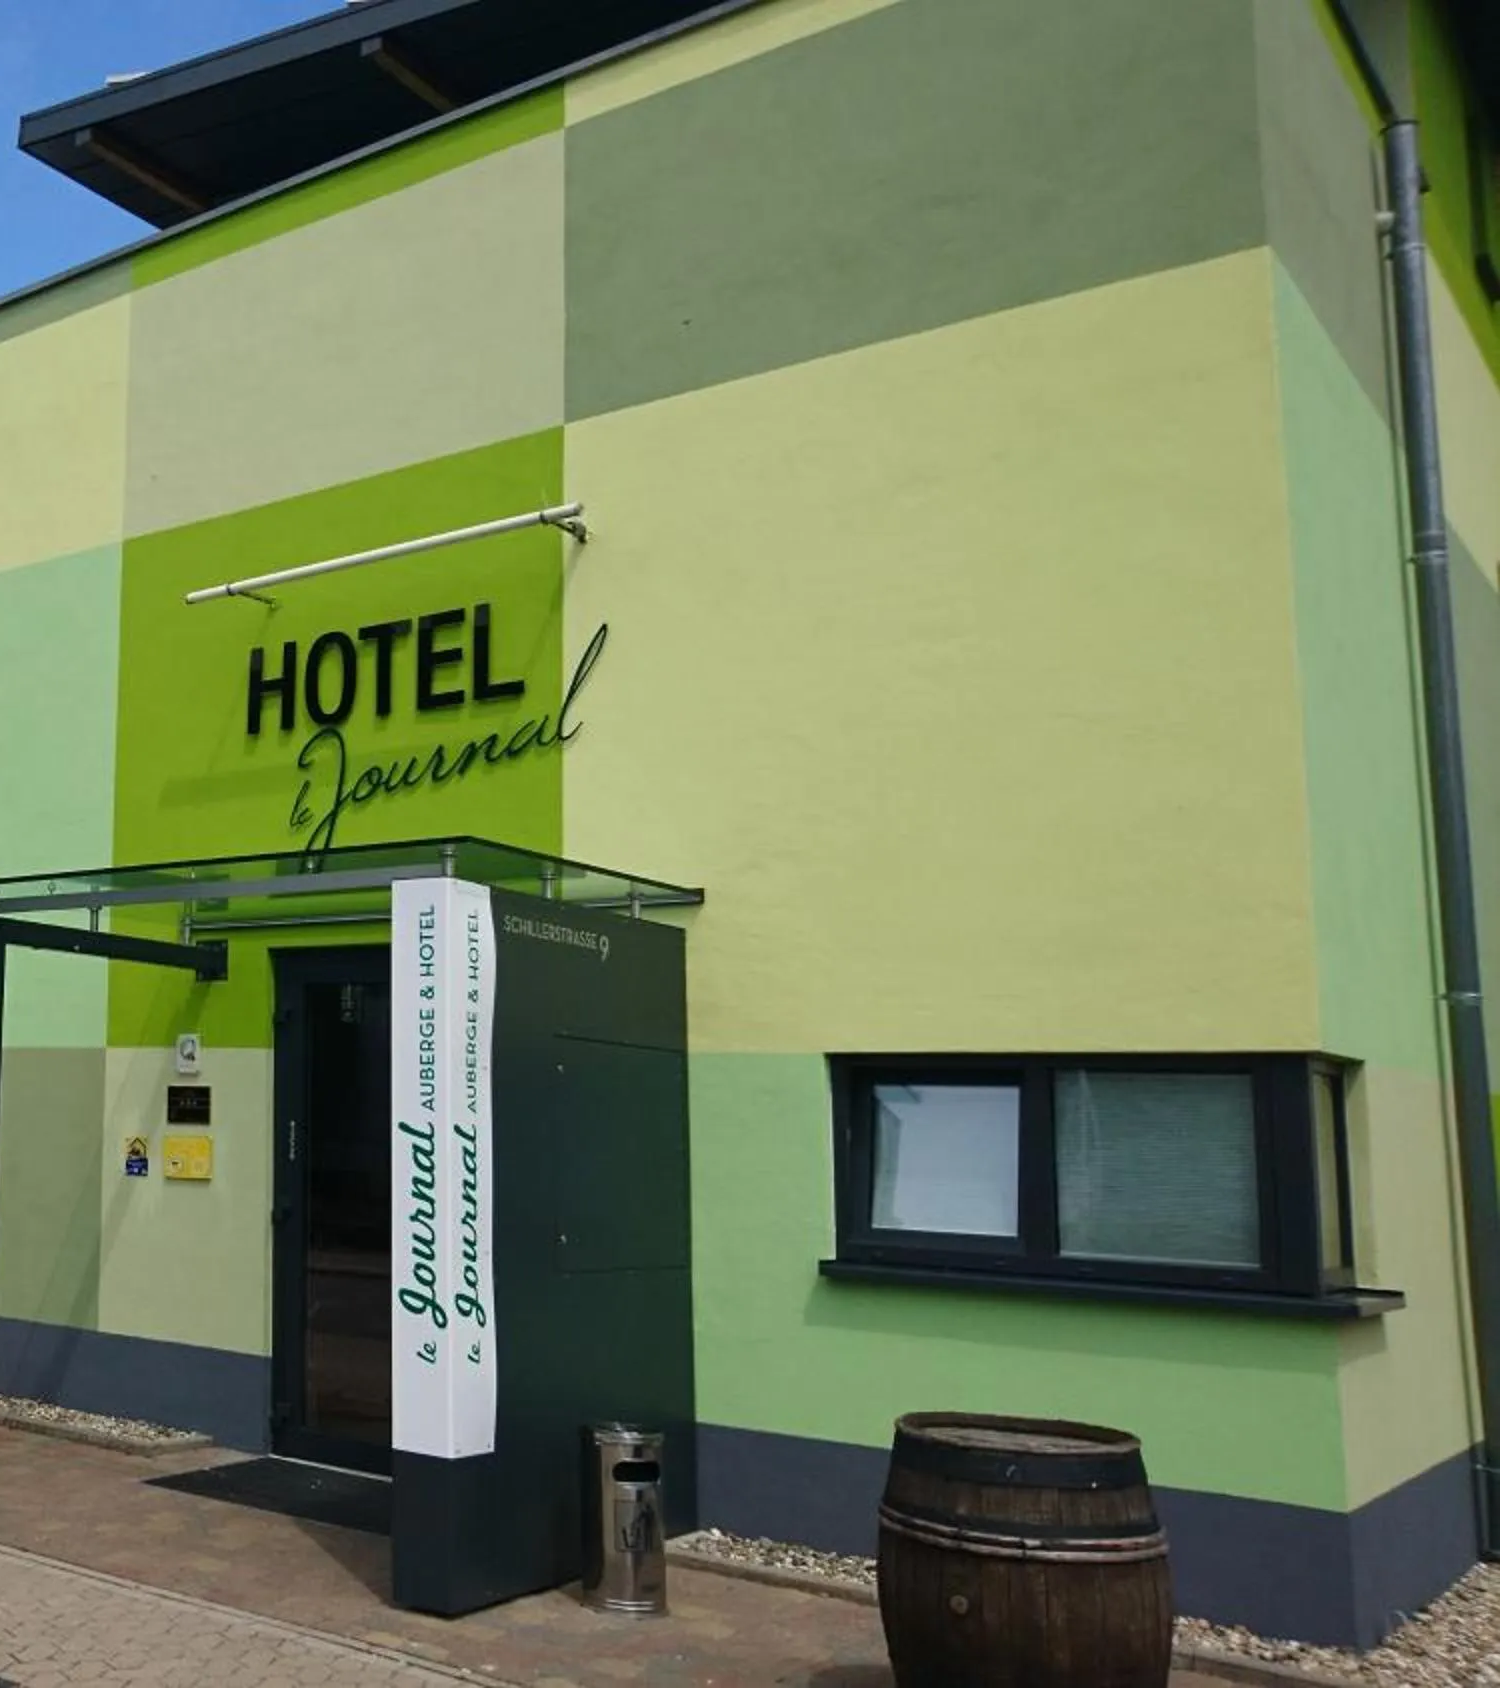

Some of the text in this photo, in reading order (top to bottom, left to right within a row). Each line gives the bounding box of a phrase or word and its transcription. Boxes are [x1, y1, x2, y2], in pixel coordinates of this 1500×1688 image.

[246, 602, 525, 736] HOTEL
[290, 623, 608, 875] le Journal
[503, 914, 610, 962] SCHILLERSTRASSE 9
[398, 904, 448, 1364] le Journal AUBERGE & HOTEL
[454, 910, 487, 1365] le Journal AUBERGE & HOTEL
